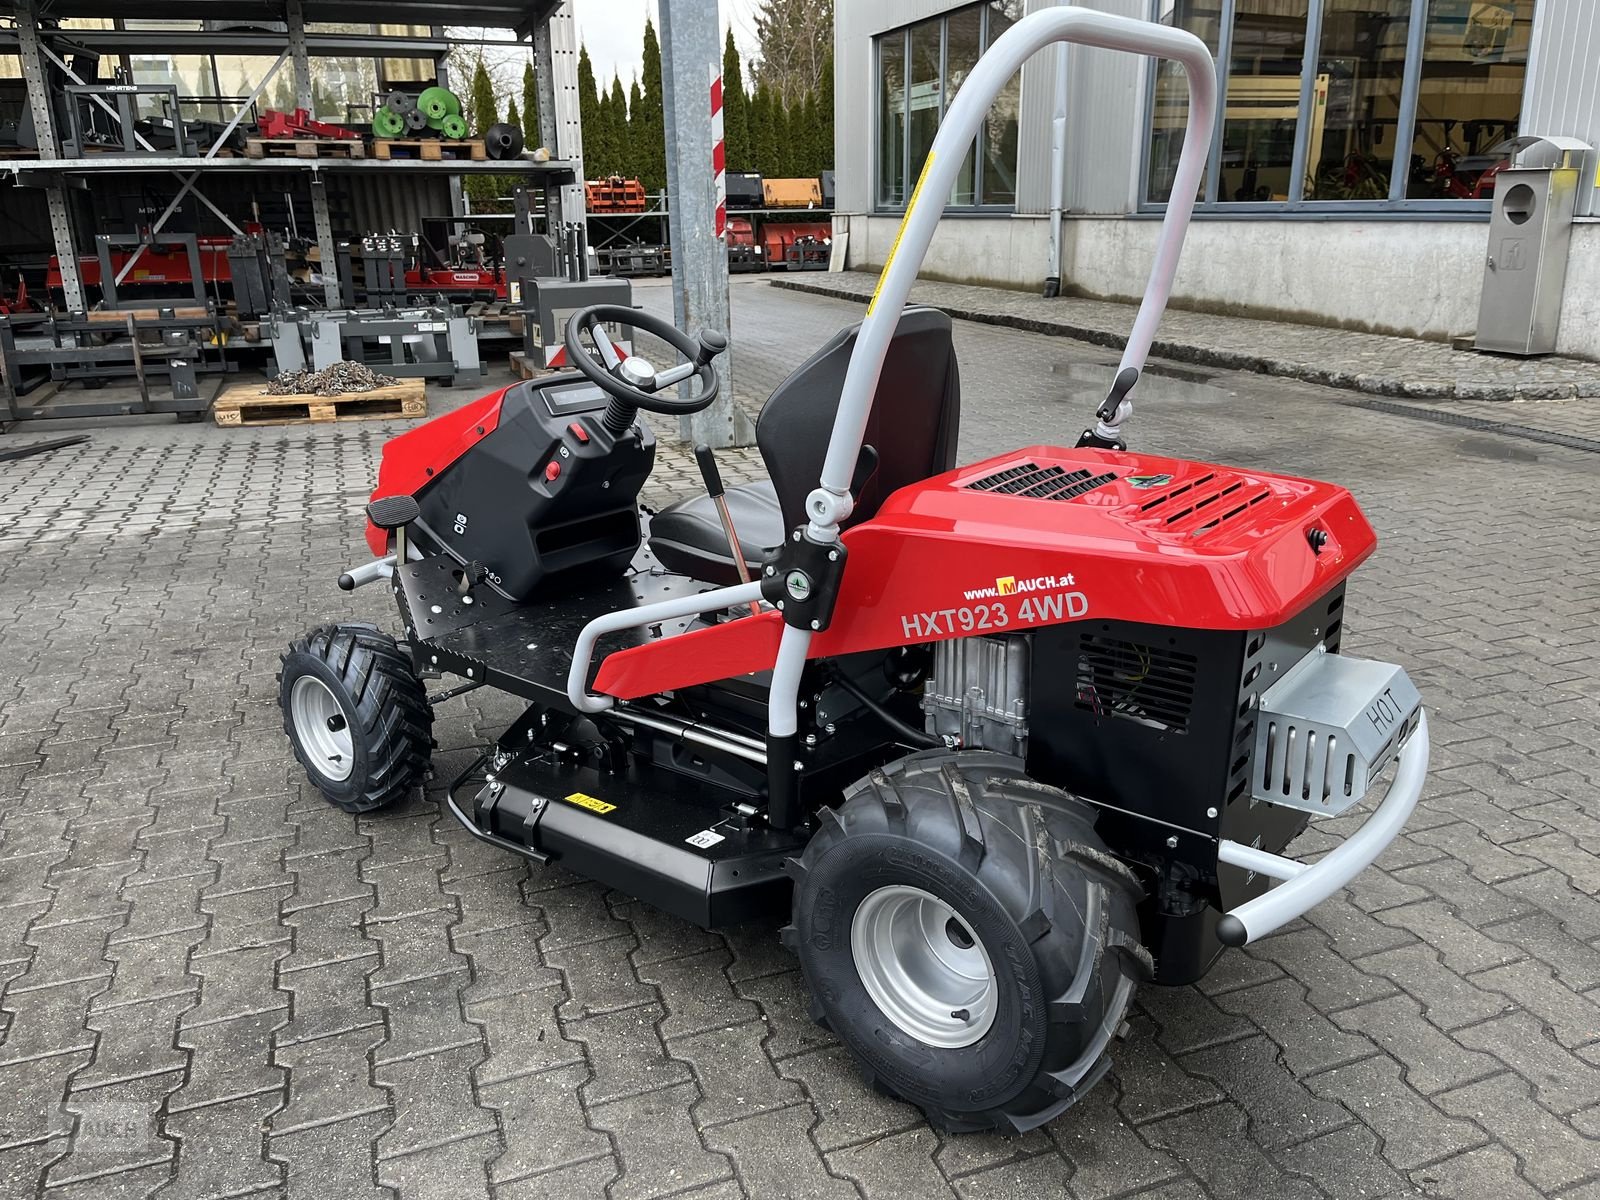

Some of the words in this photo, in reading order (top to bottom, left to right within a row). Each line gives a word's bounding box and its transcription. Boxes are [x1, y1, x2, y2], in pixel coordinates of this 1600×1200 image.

[963, 573, 1076, 601] www.MAUCH.at
[901, 602, 1009, 639] HXT923
[1017, 591, 1089, 624] 4WD
[1366, 688, 1402, 737] HOT
